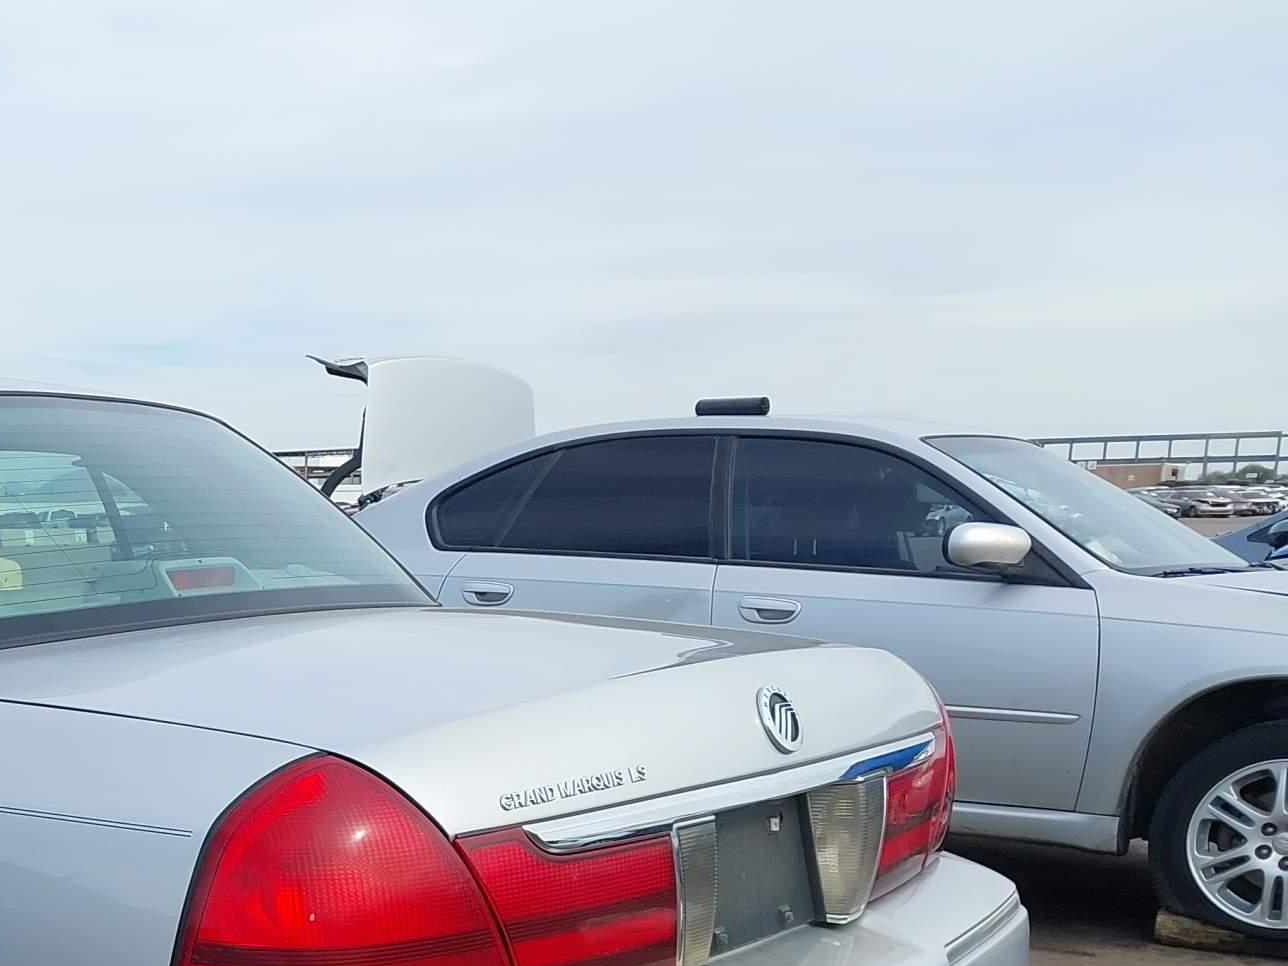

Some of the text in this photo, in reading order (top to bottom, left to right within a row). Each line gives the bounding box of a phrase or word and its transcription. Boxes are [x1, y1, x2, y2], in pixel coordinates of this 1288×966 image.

[499, 764, 648, 811] GRAND MARQUIS LS
